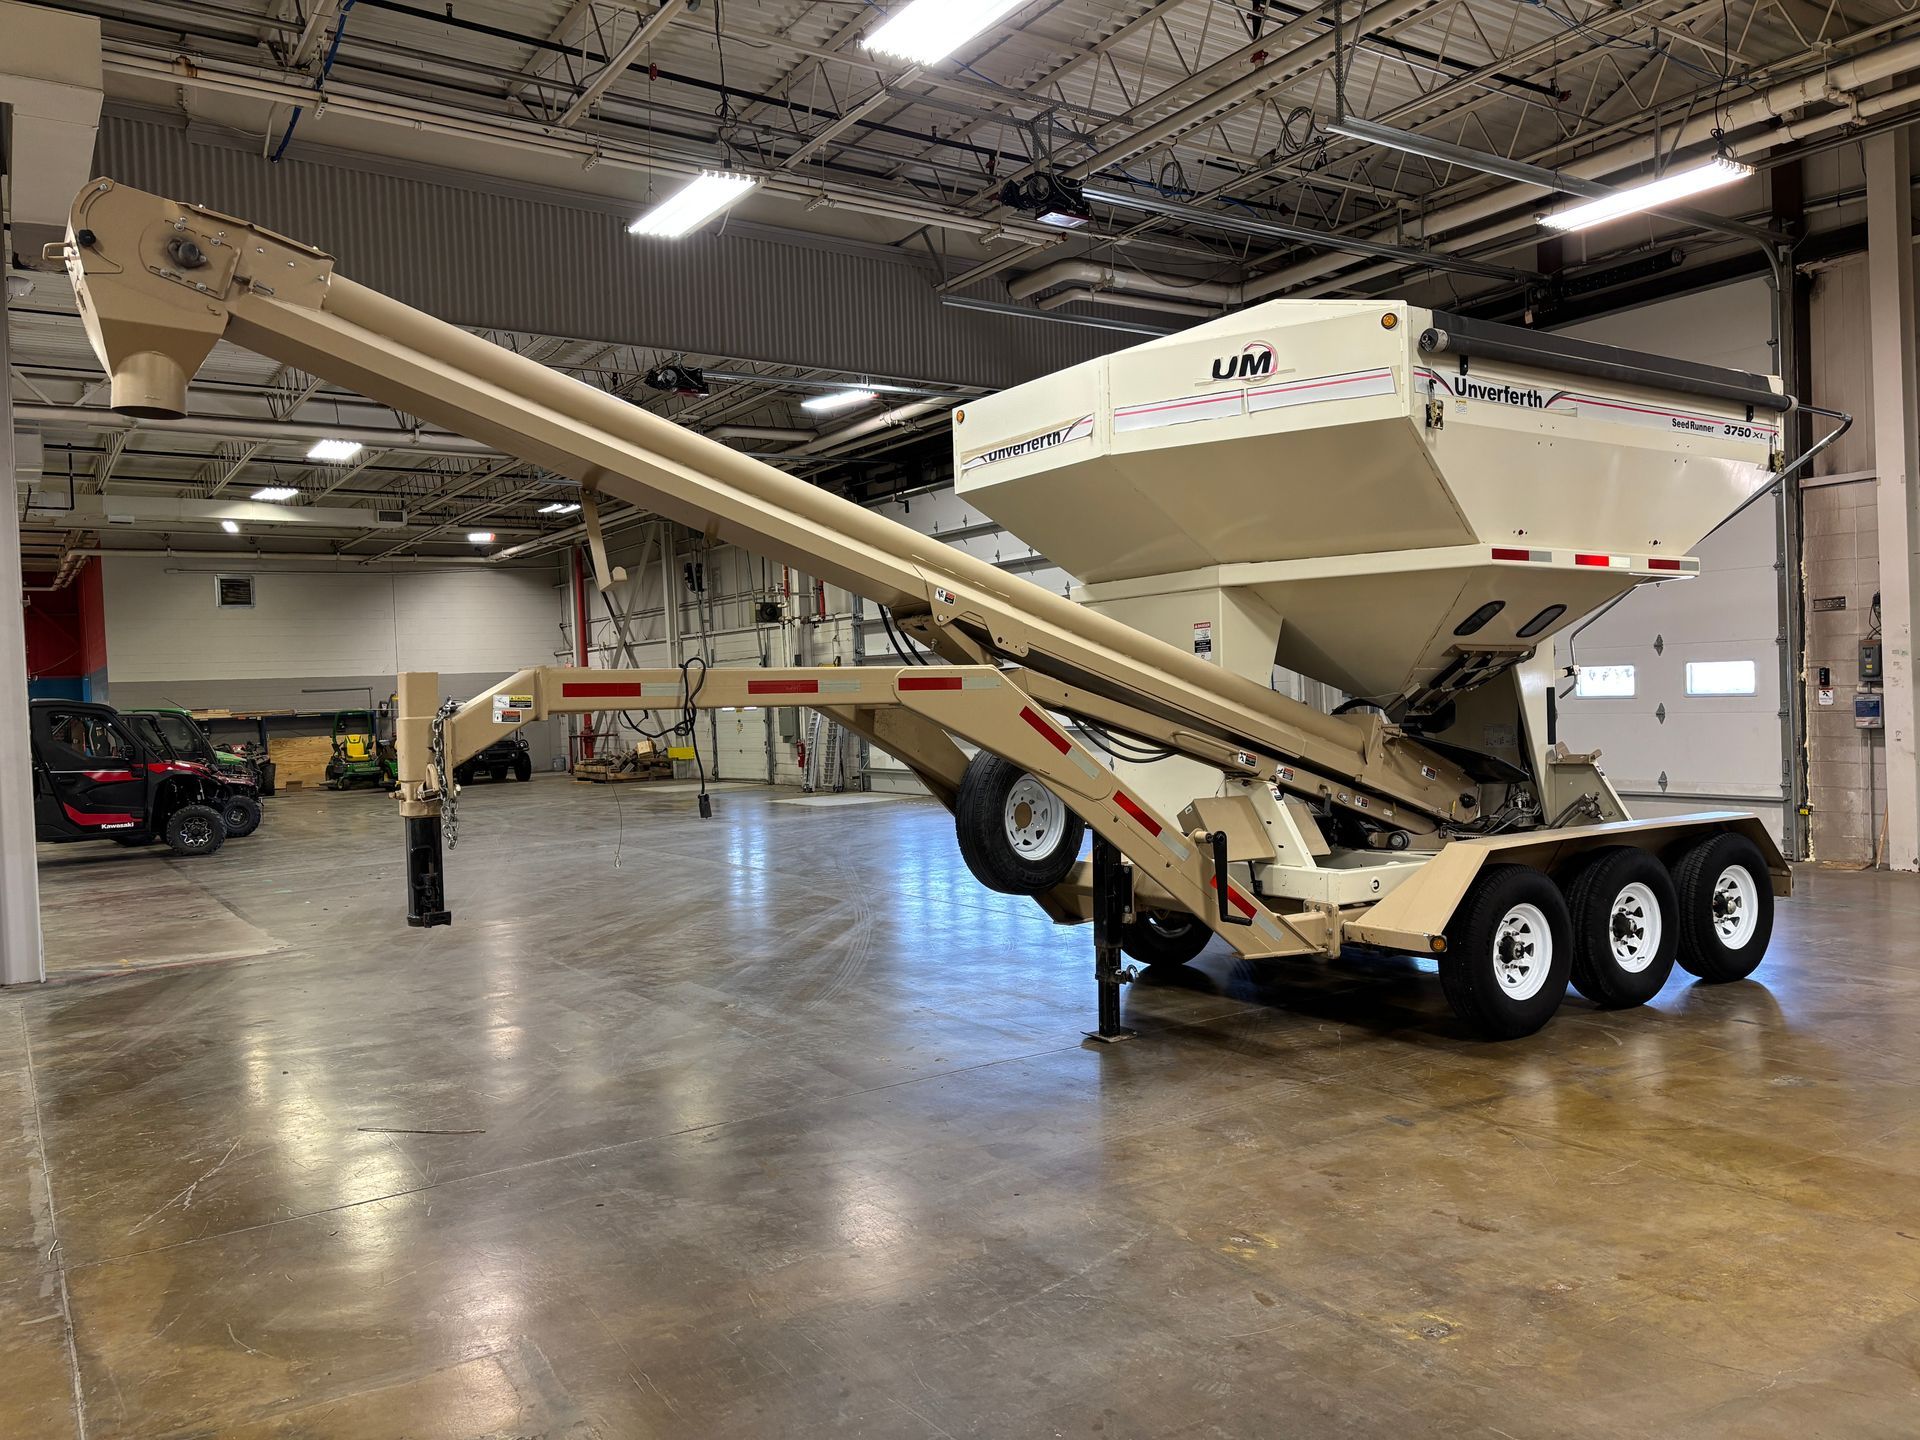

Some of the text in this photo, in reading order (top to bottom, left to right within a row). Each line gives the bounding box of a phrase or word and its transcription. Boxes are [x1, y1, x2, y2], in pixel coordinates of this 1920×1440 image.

[1212, 351, 1271, 379] UM
[1454, 377, 1543, 408] Unverferth
[1724, 425, 1751, 438] 3750
